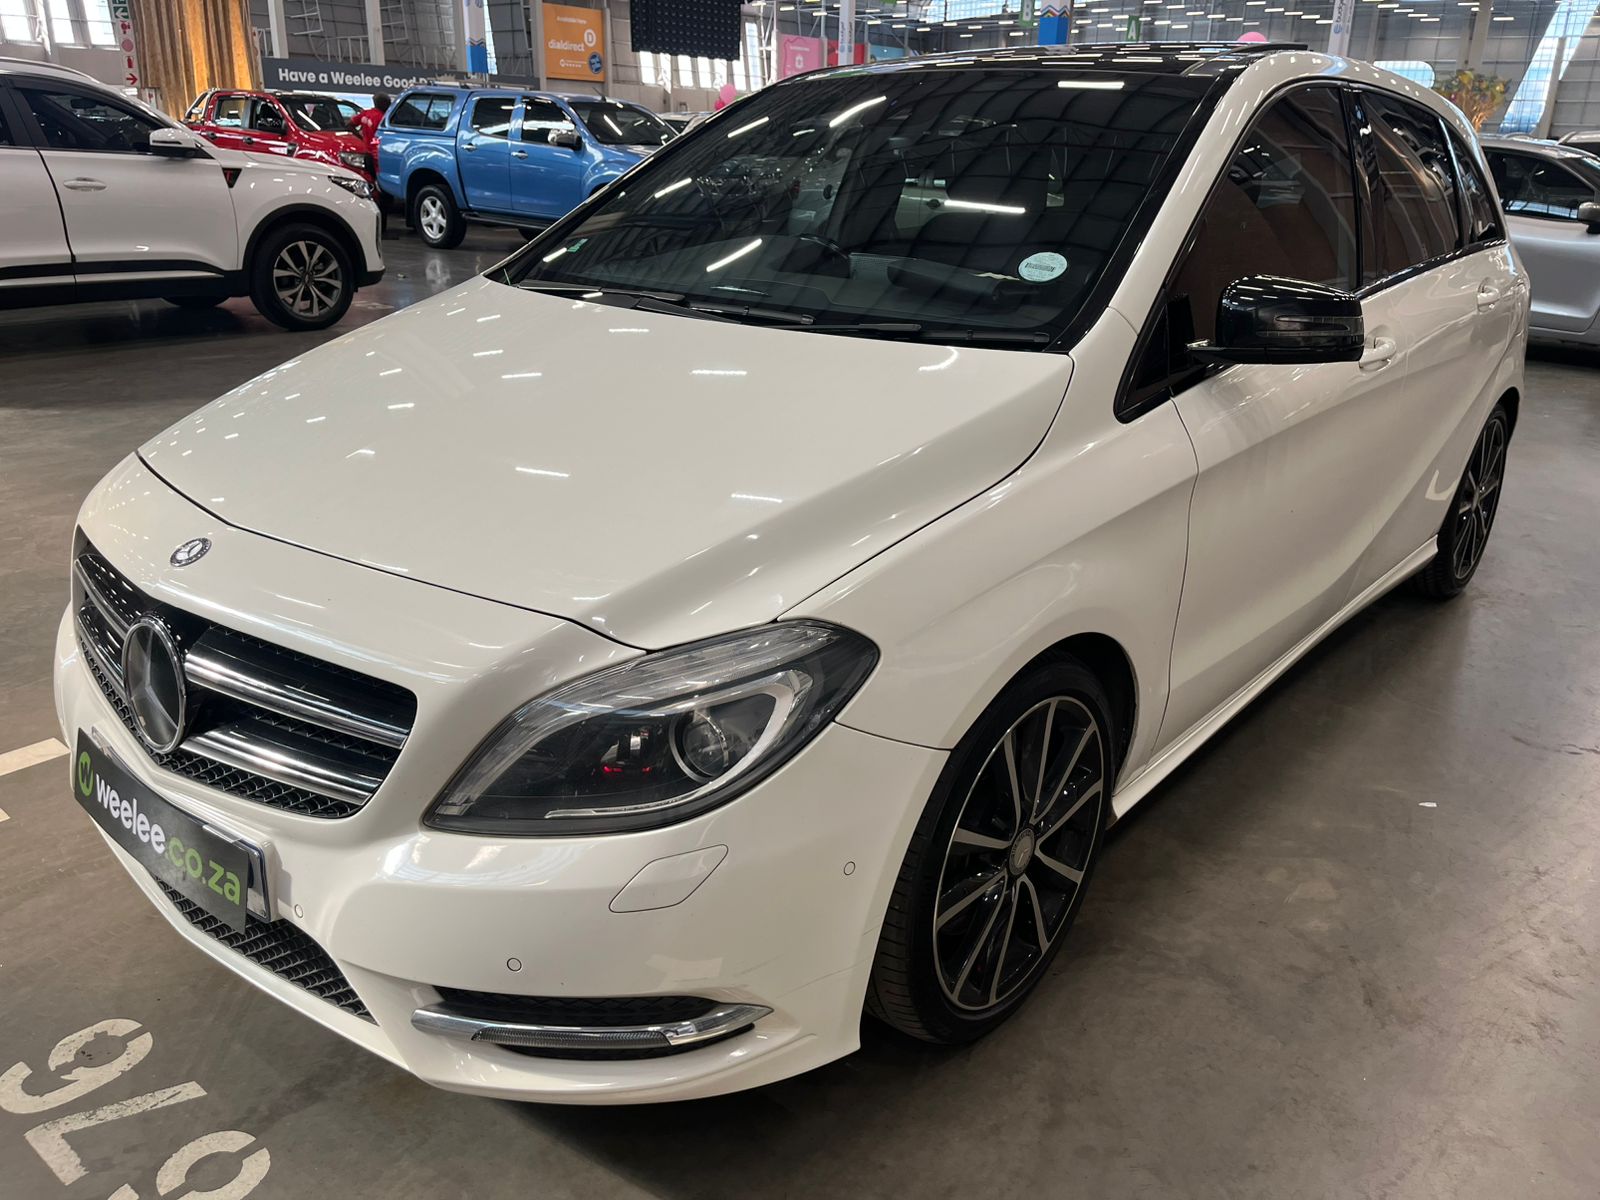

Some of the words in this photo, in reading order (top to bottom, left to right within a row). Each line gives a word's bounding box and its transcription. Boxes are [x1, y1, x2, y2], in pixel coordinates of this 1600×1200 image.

[1127, 20, 1137, 40] A
[278, 68, 316, 83] Have
[318, 73, 328, 84] a
[330, 71, 381, 87] Weelee
[96, 773, 241, 905] weelee.co.za
